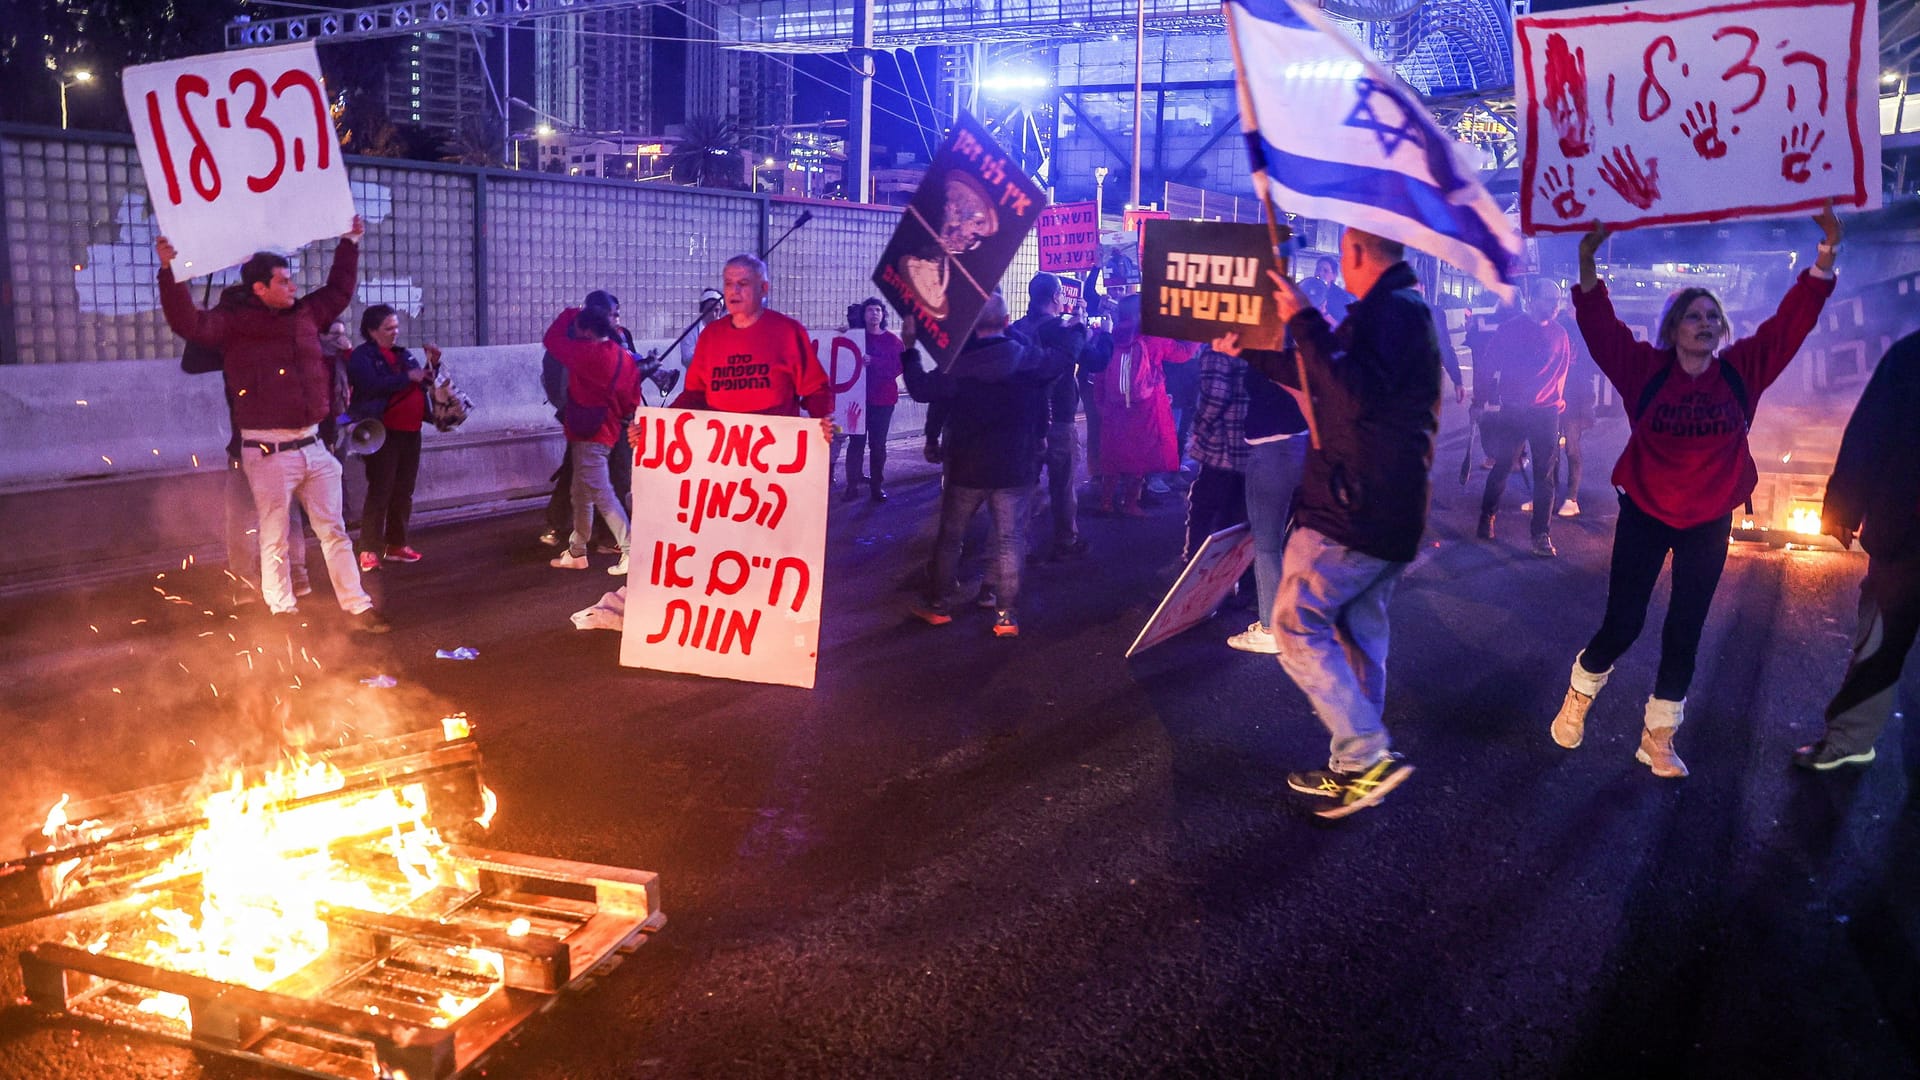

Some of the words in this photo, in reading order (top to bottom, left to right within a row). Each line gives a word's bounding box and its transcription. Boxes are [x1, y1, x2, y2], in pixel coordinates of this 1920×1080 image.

[1606, 26, 1829, 126] הצילו
[146, 68, 330, 205] הצילו
[952, 128, 985, 161] זמן
[979, 154, 1007, 186] לנו
[1000, 183, 1032, 217] אין
[1042, 211, 1092, 227] משאיות
[1166, 252, 1259, 288] עסקה
[1159, 286, 1264, 325] עכשיו!
[711, 377, 771, 392] החטופים
[712, 364, 770, 379] משפחות
[635, 412, 695, 474] לנו
[707, 419, 808, 473] נגמר
[677, 478, 787, 534] הזמן!
[650, 541, 695, 588] או
[705, 550, 810, 612] חיים
[646, 599, 761, 656] מוות
